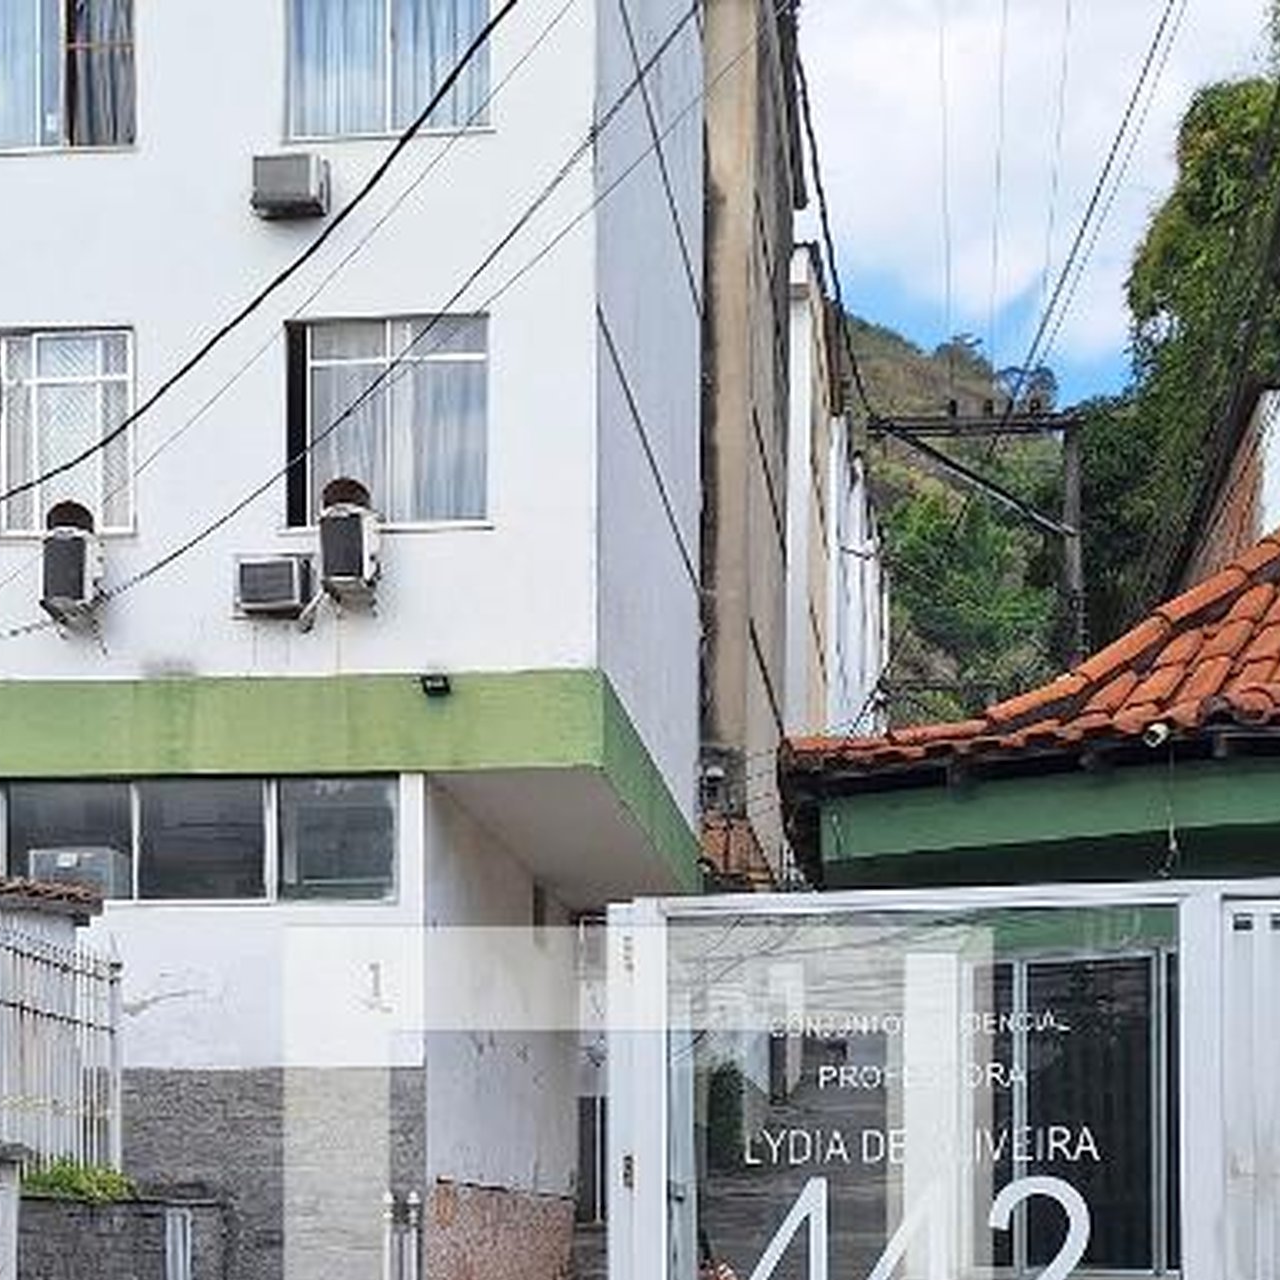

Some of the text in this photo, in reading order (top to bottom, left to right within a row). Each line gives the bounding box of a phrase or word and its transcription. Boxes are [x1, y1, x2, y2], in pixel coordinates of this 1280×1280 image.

[915, 1010, 1072, 1034] DENCIAL
[817, 1062, 1027, 1090] PROFEORA
[743, 1125, 1102, 1166] LYDIA DE IVEIRA
